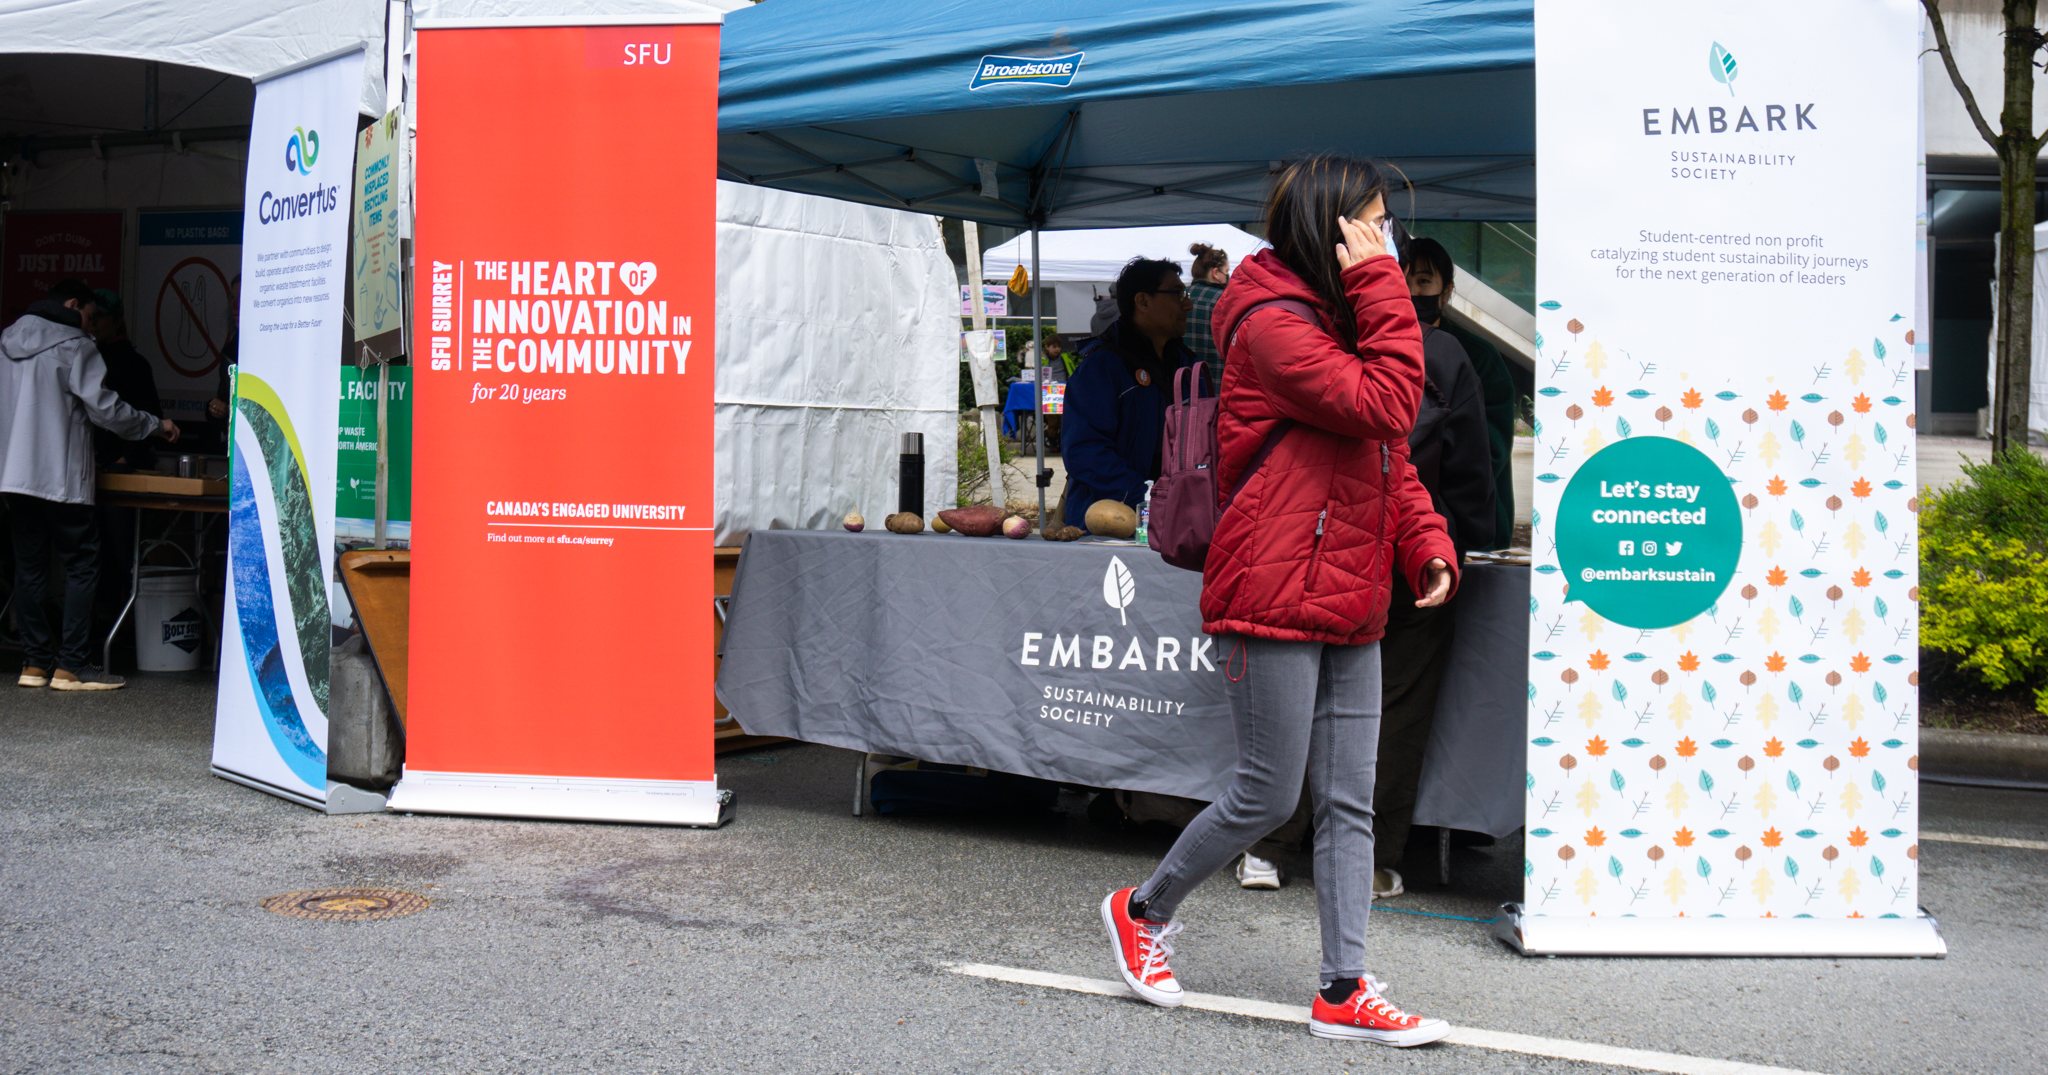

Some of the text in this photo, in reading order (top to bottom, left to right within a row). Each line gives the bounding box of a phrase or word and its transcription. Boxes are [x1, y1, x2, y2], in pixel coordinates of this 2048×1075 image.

[623, 43, 672, 65] SFU
[981, 62, 1073, 76] Broadstone
[1642, 103, 1818, 136] EMBARK
[1671, 150, 1796, 166] SUSTAINABILITY
[1671, 167, 1736, 180] SOCIETY
[65, 232, 92, 247] DUMP
[1639, 230, 1824, 250] Student-centred non profit
[17, 254, 104, 272] JUST DIAL
[1590, 248, 1869, 271] catalyzing student sustainability journeys
[474, 261, 648, 296] THE HEART OF
[1616, 266, 1846, 286] for the next generation of leaders
[431, 260, 452, 371] SFU SURREY
[473, 299, 692, 336] INNOVATION IN
[472, 338, 692, 374] THE COMMUNITY
[348, 381, 406, 400] FACITY
[470, 382, 566, 404] for 20 years
[344, 427, 365, 436] WASTE
[338, 441, 355, 450] ORTH
[1600, 480, 1700, 503] Let's stay
[552, 502, 609, 519] ENGAGED
[612, 504, 686, 520] UNIVERSITY
[1592, 507, 1706, 525] connected
[487, 532, 614, 547] Find out more at sfu.ca/surrey
[1581, 567, 1715, 582] @embarksustain
[164, 624, 185, 641] BOLT
[1021, 632, 1216, 672] EMBARK
[1043, 686, 1185, 716] SUSTAINABILITY
[1040, 706, 1114, 728] SOCIETY
